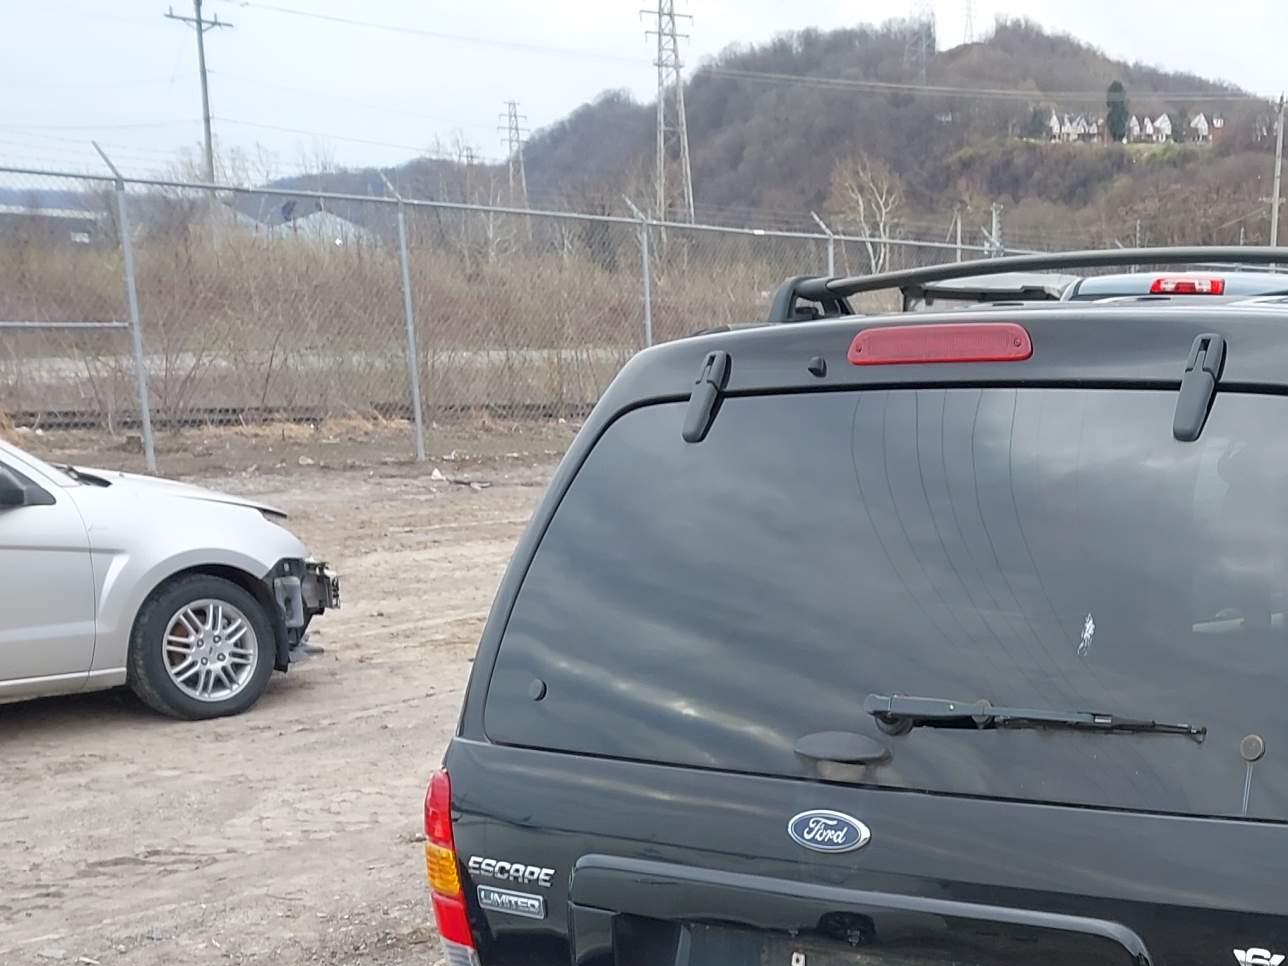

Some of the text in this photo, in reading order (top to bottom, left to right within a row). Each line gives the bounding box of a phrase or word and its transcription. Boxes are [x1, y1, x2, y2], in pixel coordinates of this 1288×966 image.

[803, 816, 849, 844] Ford
[468, 855, 556, 888] ESCAPE
[480, 889, 541, 914] LIMITED
